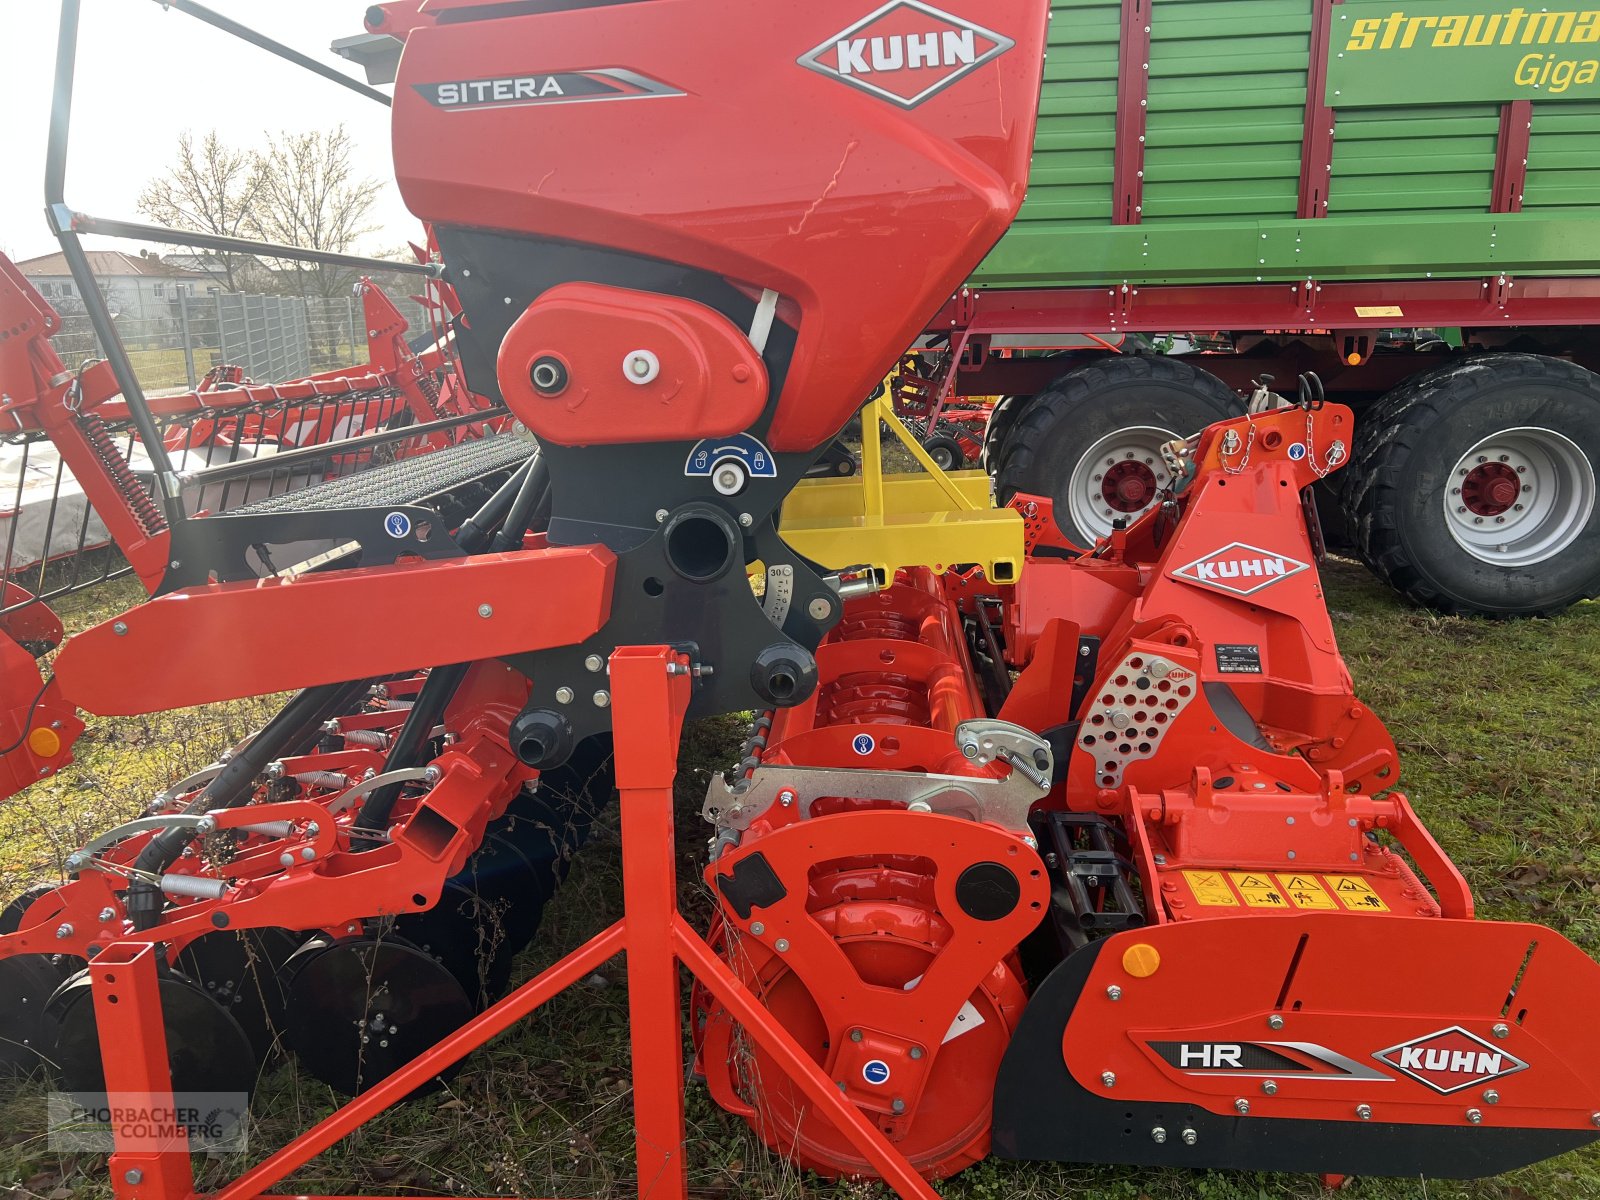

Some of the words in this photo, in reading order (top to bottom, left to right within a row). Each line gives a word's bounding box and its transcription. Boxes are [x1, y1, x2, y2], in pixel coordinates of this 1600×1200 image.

[836, 29, 975, 75] KUHN
[1514, 53, 1600, 93] Giga
[437, 76, 564, 105] SITERA
[770, 569, 781, 577] 30
[1196, 558, 1286, 580] KUHN
[1180, 1044, 1244, 1068] HR
[1399, 1047, 1502, 1075] KUHN
